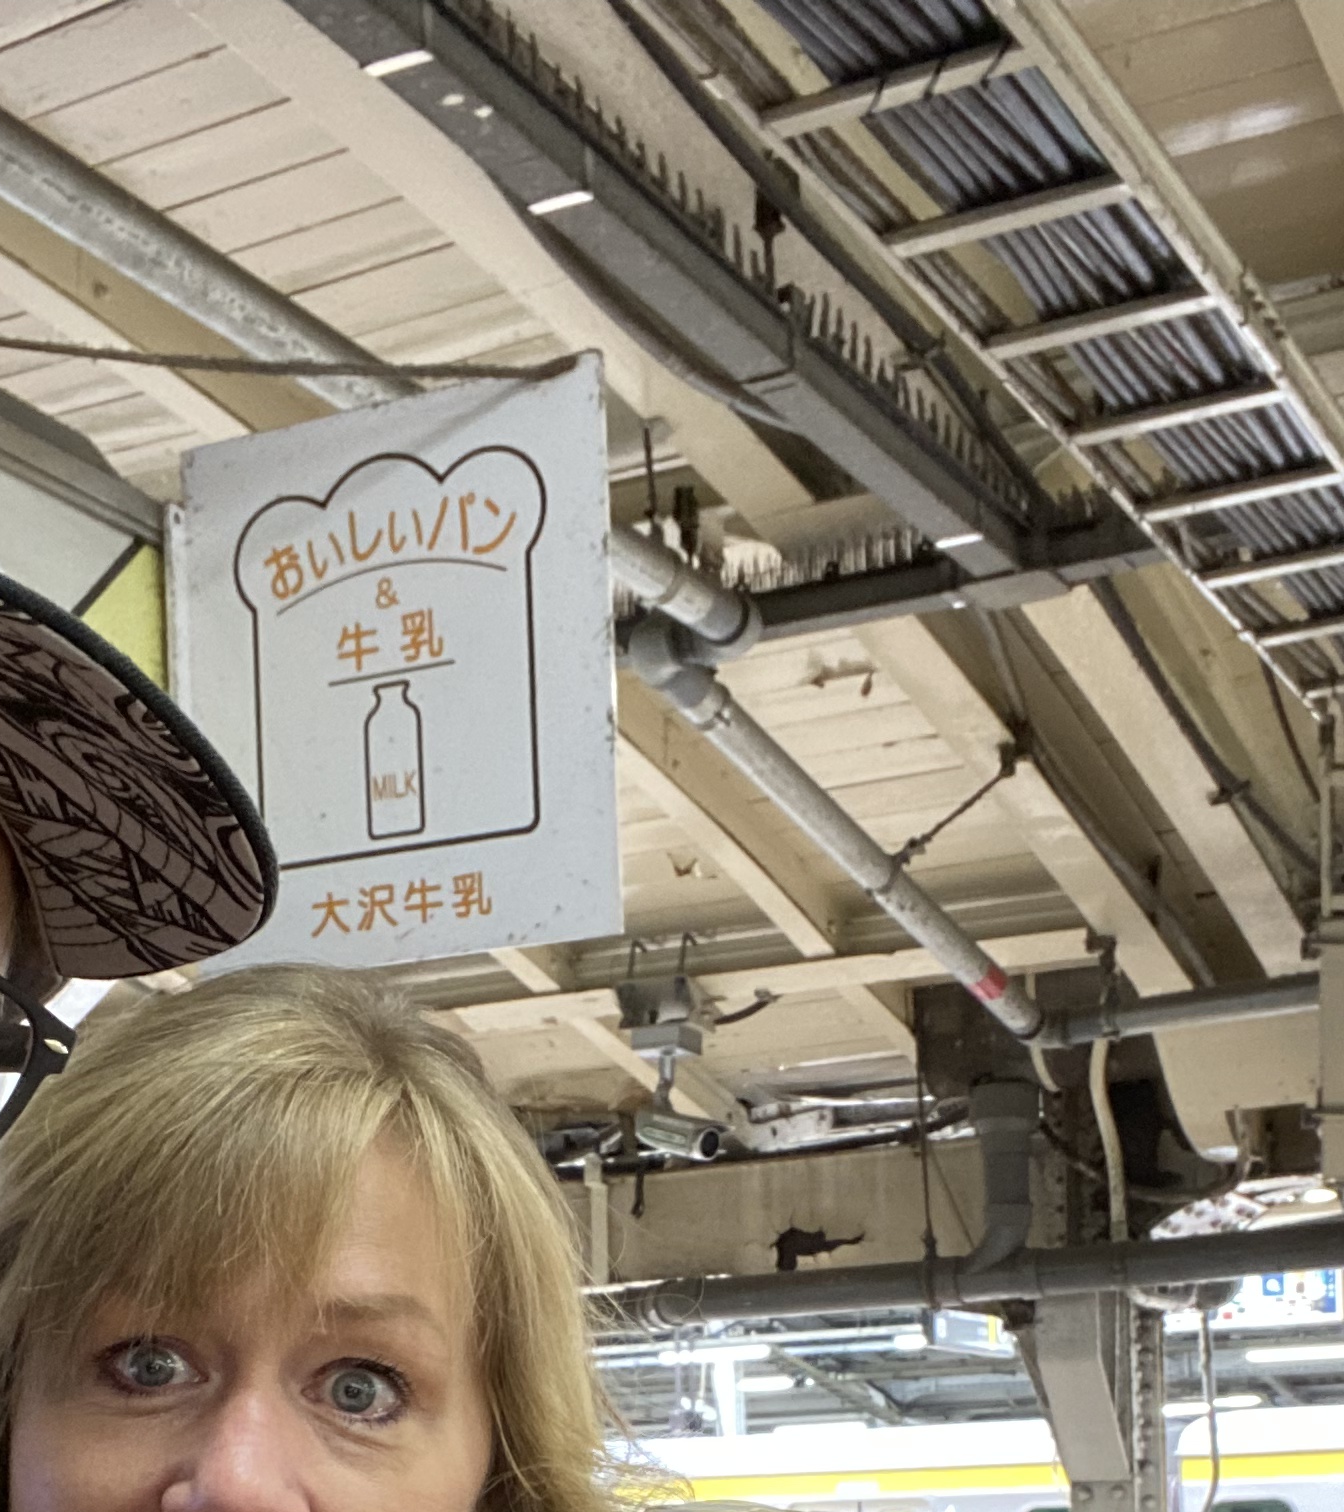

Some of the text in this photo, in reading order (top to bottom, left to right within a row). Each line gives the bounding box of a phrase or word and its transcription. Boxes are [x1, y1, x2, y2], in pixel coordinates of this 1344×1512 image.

[263, 491, 517, 600] おいしいパン
[375, 576, 400, 609] &
[337, 608, 444, 672] 牛乳
[370, 769, 417, 801] MILK
[311, 871, 493, 938] 大沢牛乳
